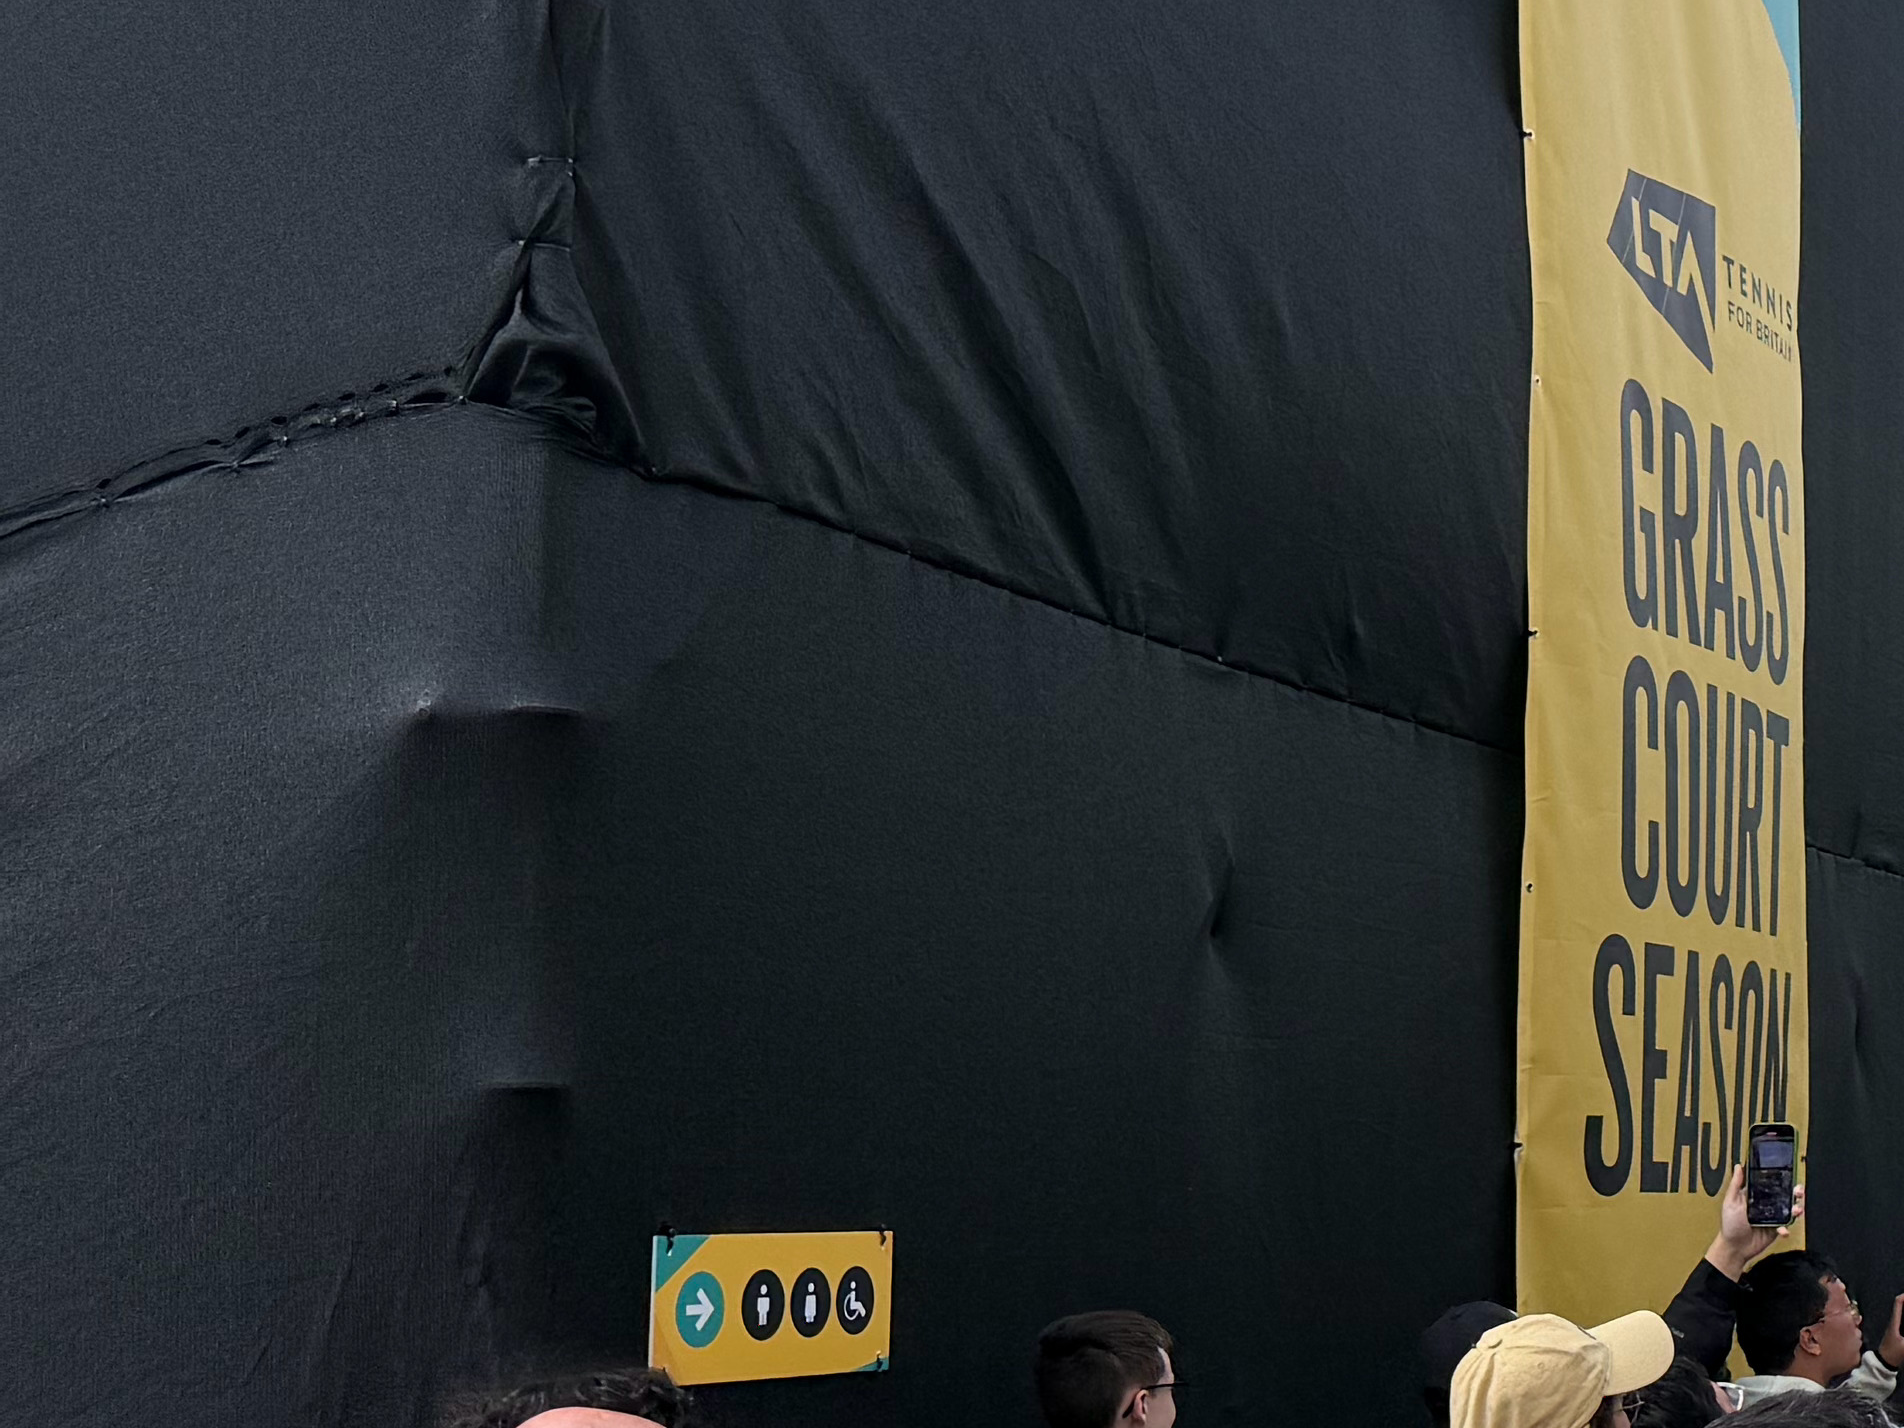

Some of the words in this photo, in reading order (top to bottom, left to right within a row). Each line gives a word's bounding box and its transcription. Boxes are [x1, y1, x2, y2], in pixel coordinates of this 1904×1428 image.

[1631, 196, 1716, 333] LTA
[1722, 254, 1793, 332] TENNIS
[1728, 300, 1753, 334] FOR
[1620, 378, 1790, 686] GRASS
[1620, 655, 1790, 937] COURT
[1583, 932, 1792, 1197] SEASON
